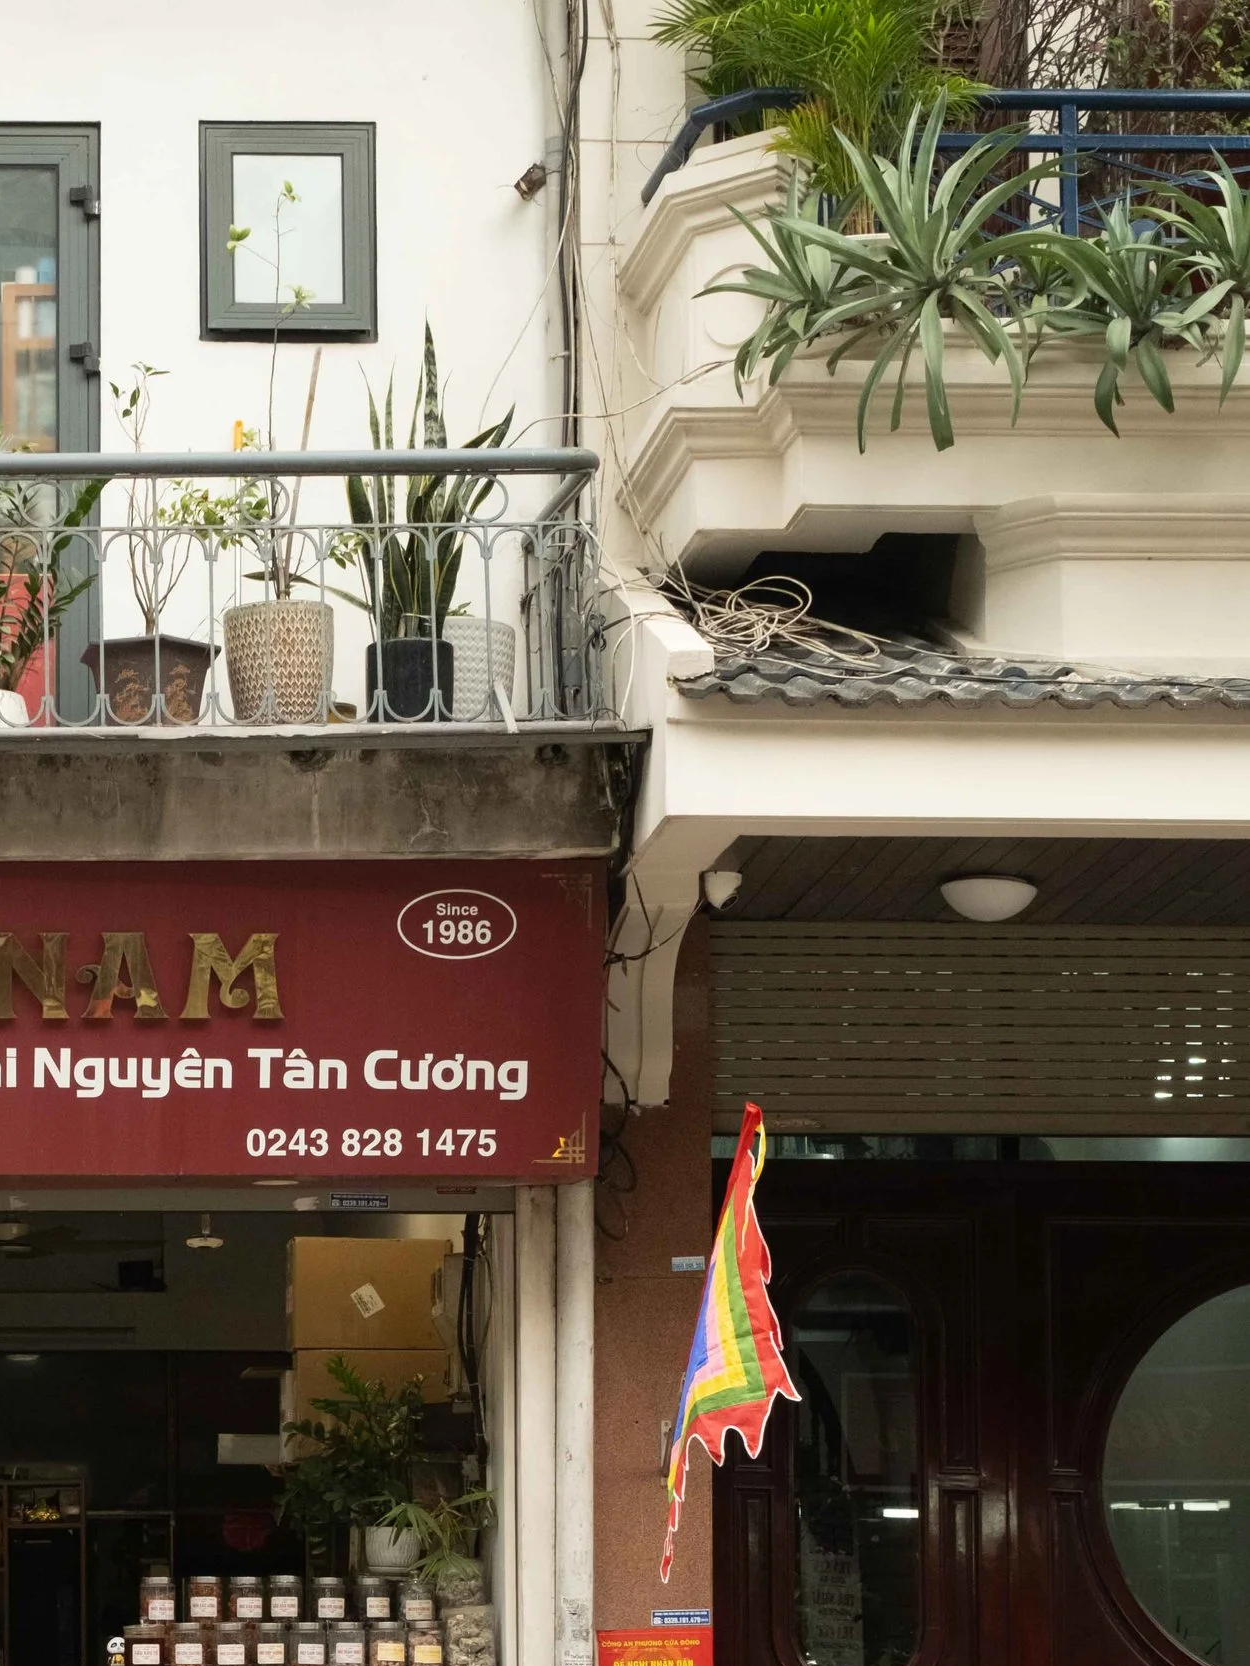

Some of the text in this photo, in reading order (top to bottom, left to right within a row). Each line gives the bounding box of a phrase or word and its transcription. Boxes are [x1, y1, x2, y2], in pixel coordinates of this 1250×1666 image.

[436, 902, 479, 916] Since
[422, 919, 492, 945] 1986
[33, 1047, 233, 1099] Nguyên
[247, 1047, 348, 1090] Tân
[363, 1049, 529, 1101] Cương
[246, 1128, 497, 1157] 0243 828 1475
